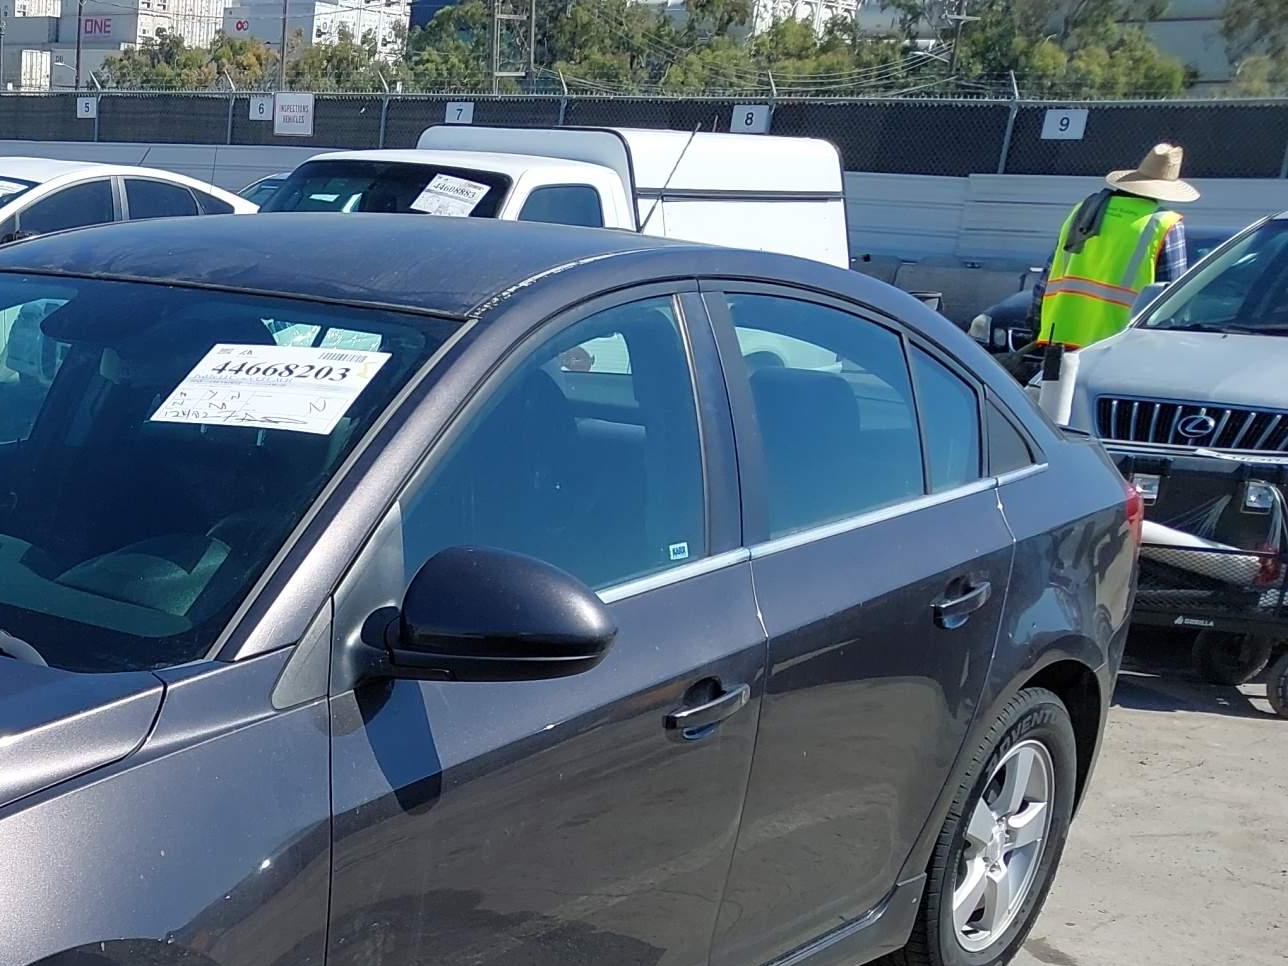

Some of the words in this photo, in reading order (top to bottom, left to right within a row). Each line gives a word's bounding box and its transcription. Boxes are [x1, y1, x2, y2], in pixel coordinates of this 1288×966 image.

[84, 18, 112, 35] ONE
[83, 102, 91, 113] 5
[258, 103, 265, 114] 6
[455, 109, 464, 121] 7
[744, 112, 755, 126] 8
[1058, 116, 1070, 132] 9
[212, 360, 351, 382] 44668203
